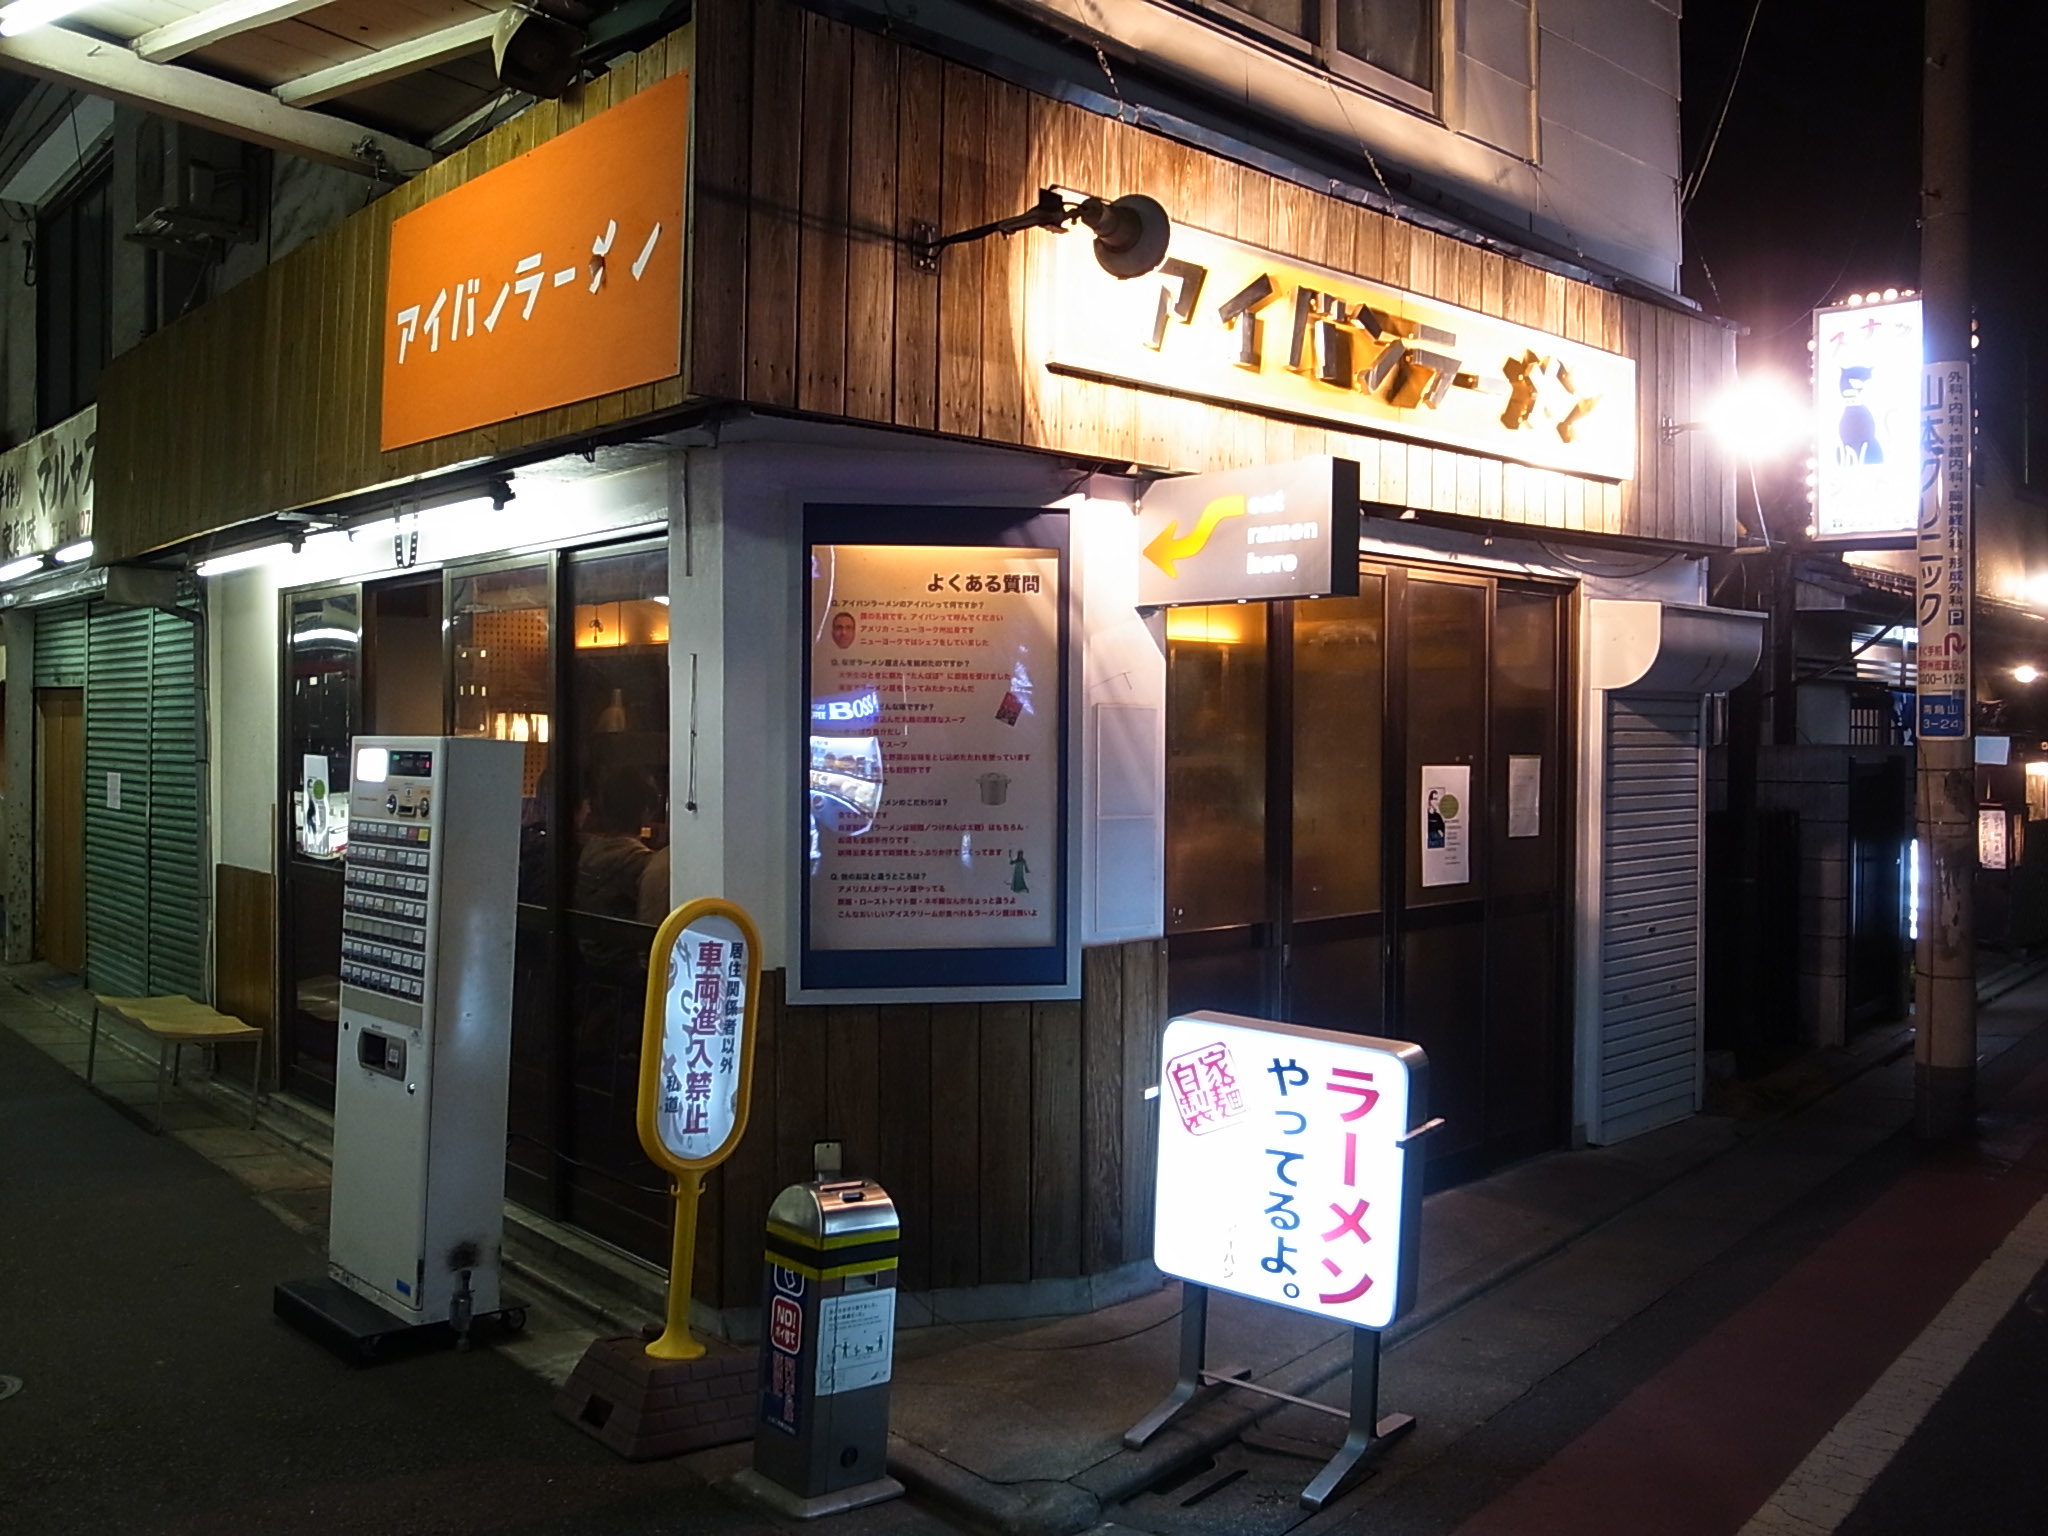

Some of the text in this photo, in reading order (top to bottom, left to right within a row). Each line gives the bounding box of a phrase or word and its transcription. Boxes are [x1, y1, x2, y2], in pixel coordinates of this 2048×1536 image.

[397, 219, 662, 364] アイバンラーメン
[1247, 520, 1318, 544] ramen
[1248, 489, 1286, 514] eat
[1919, 374, 1945, 627] 山本クリニック
[927, 573, 1041, 594] よくある質問
[1246, 552, 1298, 574] here
[682, 941, 724, 1135] 車両進入禁止
[719, 942, 744, 1075] 居住関係者以外
[664, 1075, 682, 1114] 私道
[1260, 1057, 1309, 1299] やってるよ。
[1318, 1067, 1381, 1304] ラーメン
[776, 1305, 798, 1330] NO!
